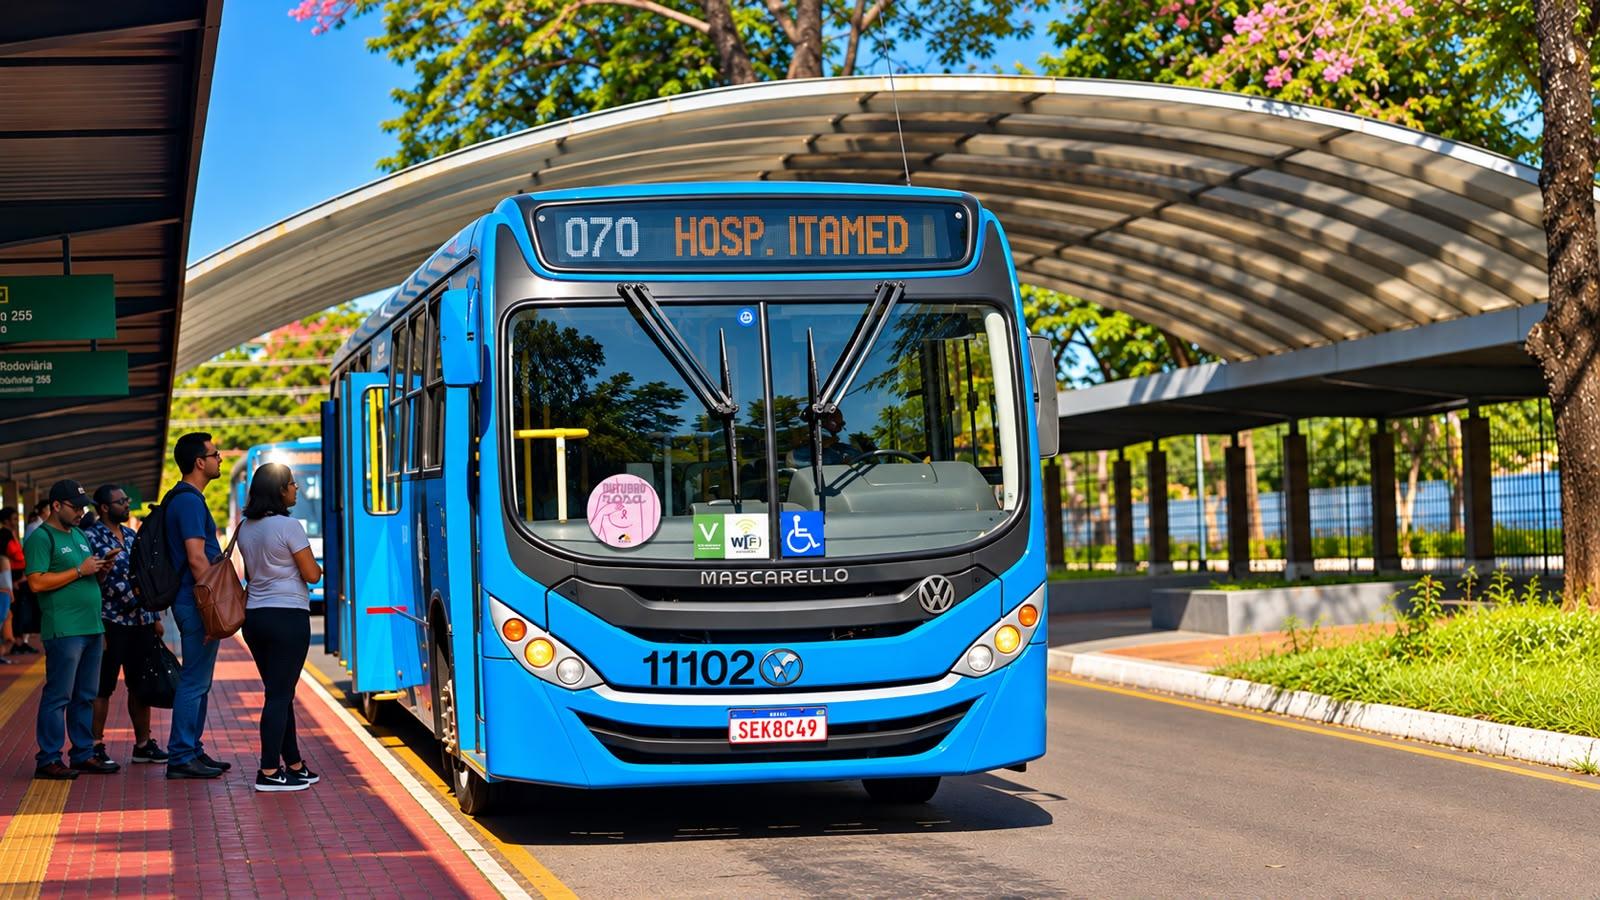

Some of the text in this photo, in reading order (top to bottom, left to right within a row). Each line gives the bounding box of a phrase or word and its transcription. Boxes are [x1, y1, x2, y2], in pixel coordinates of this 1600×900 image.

[565, 215, 909, 257] 070 HOSP. ITAMED
[11, 310, 32, 321] 255
[700, 568, 849, 585] MASCARELLO
[643, 650, 755, 686] 11102
[738, 719, 817, 739] SEK8C49
